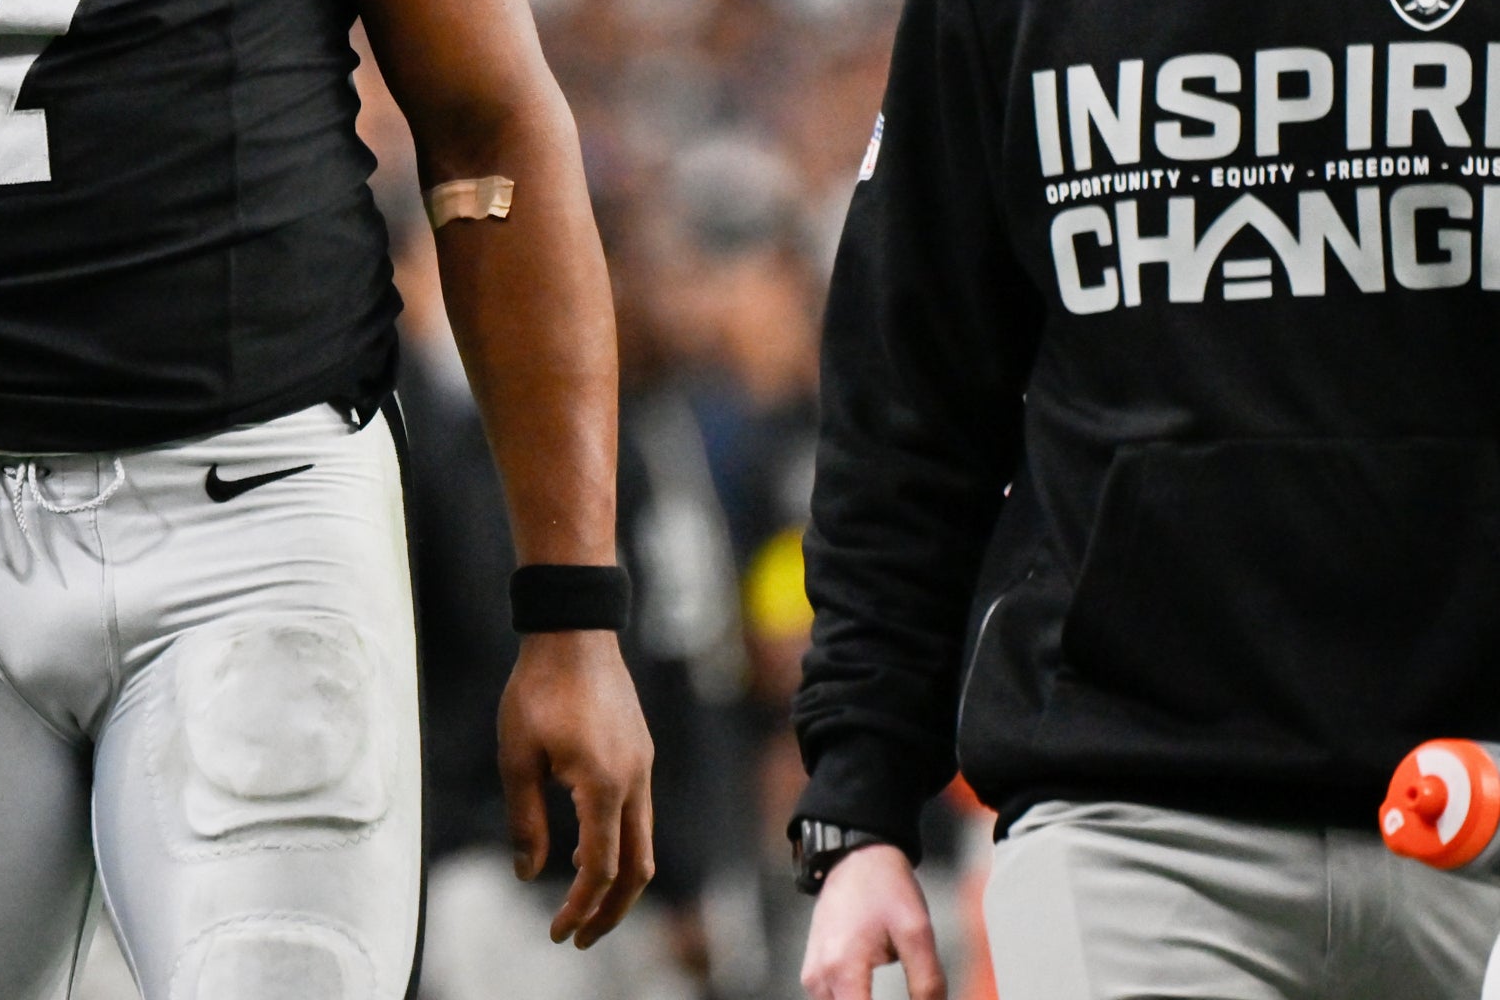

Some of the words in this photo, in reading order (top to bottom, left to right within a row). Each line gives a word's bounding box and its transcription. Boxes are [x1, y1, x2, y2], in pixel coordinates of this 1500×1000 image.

[1032, 41, 1500, 178] INSPIR
[1045, 167, 1181, 205] OPPORTUNITY
[1211, 163, 1295, 189] EQUITY
[1325, 156, 1430, 182] FREEDOM
[1050, 184, 1500, 315] CHANG
